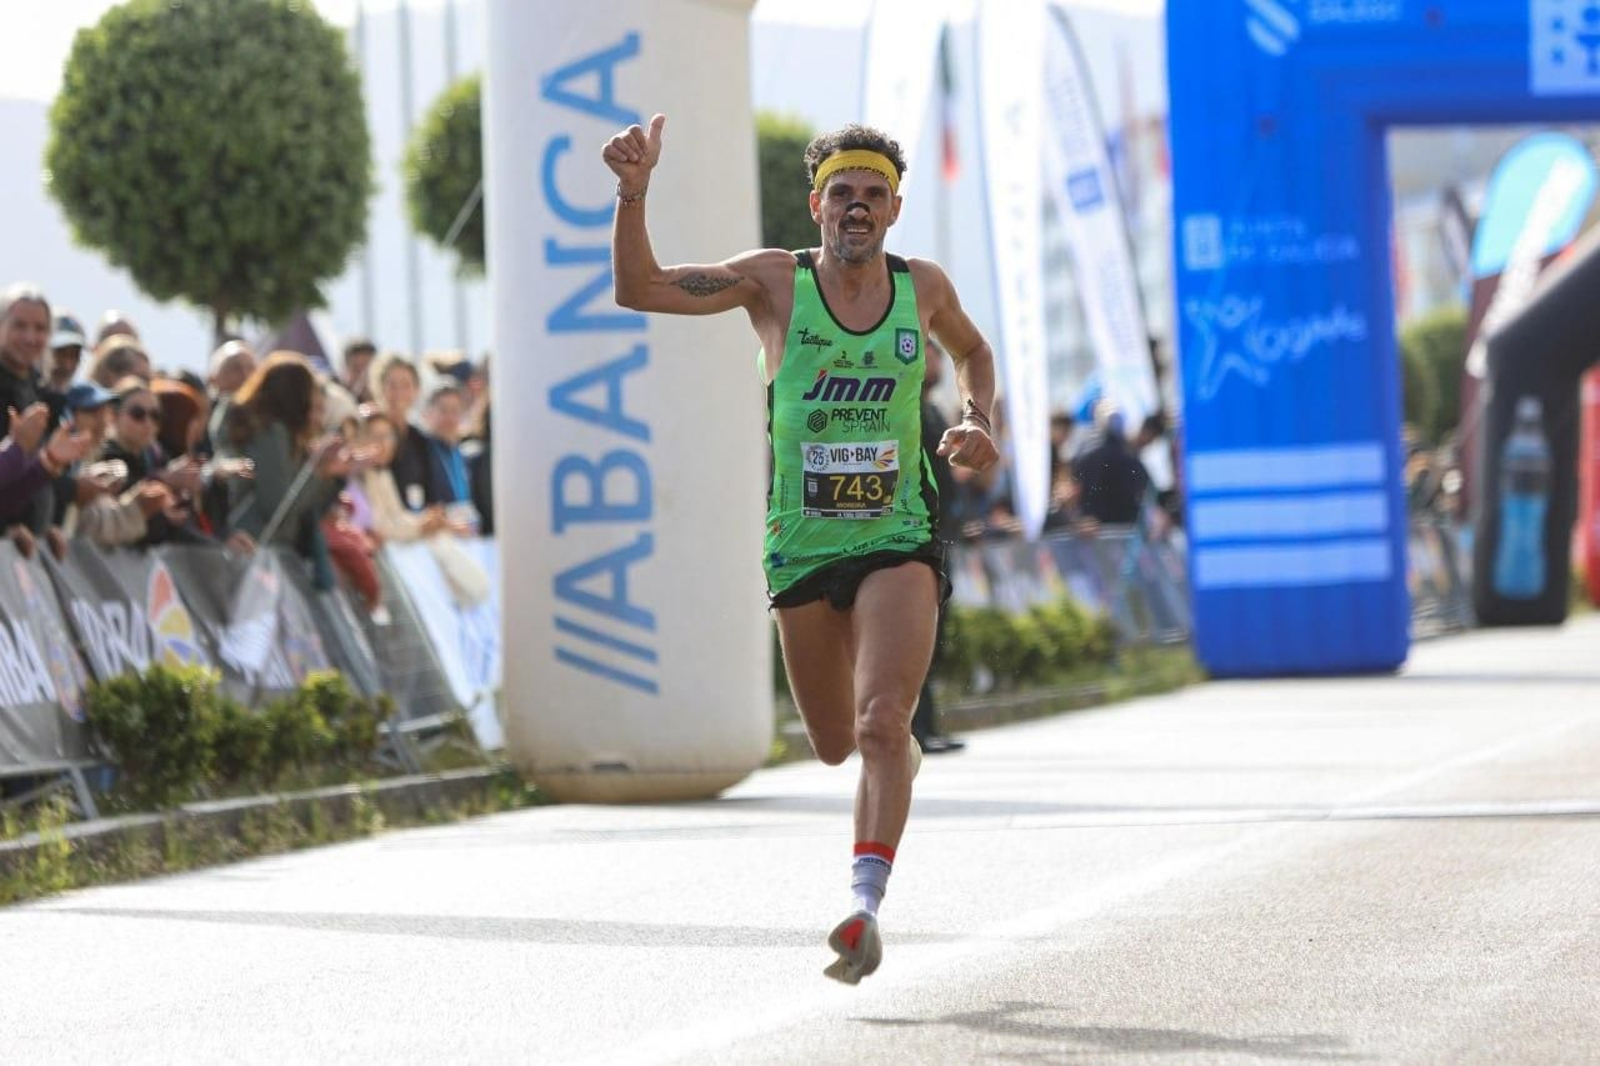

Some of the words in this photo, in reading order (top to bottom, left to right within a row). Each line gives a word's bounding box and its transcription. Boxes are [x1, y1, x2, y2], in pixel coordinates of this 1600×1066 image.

[540, 31, 656, 633] ABANCA
[831, 408, 888, 421] PREVENT
[841, 420, 891, 433] SPRAIN
[829, 474, 883, 501] 743
